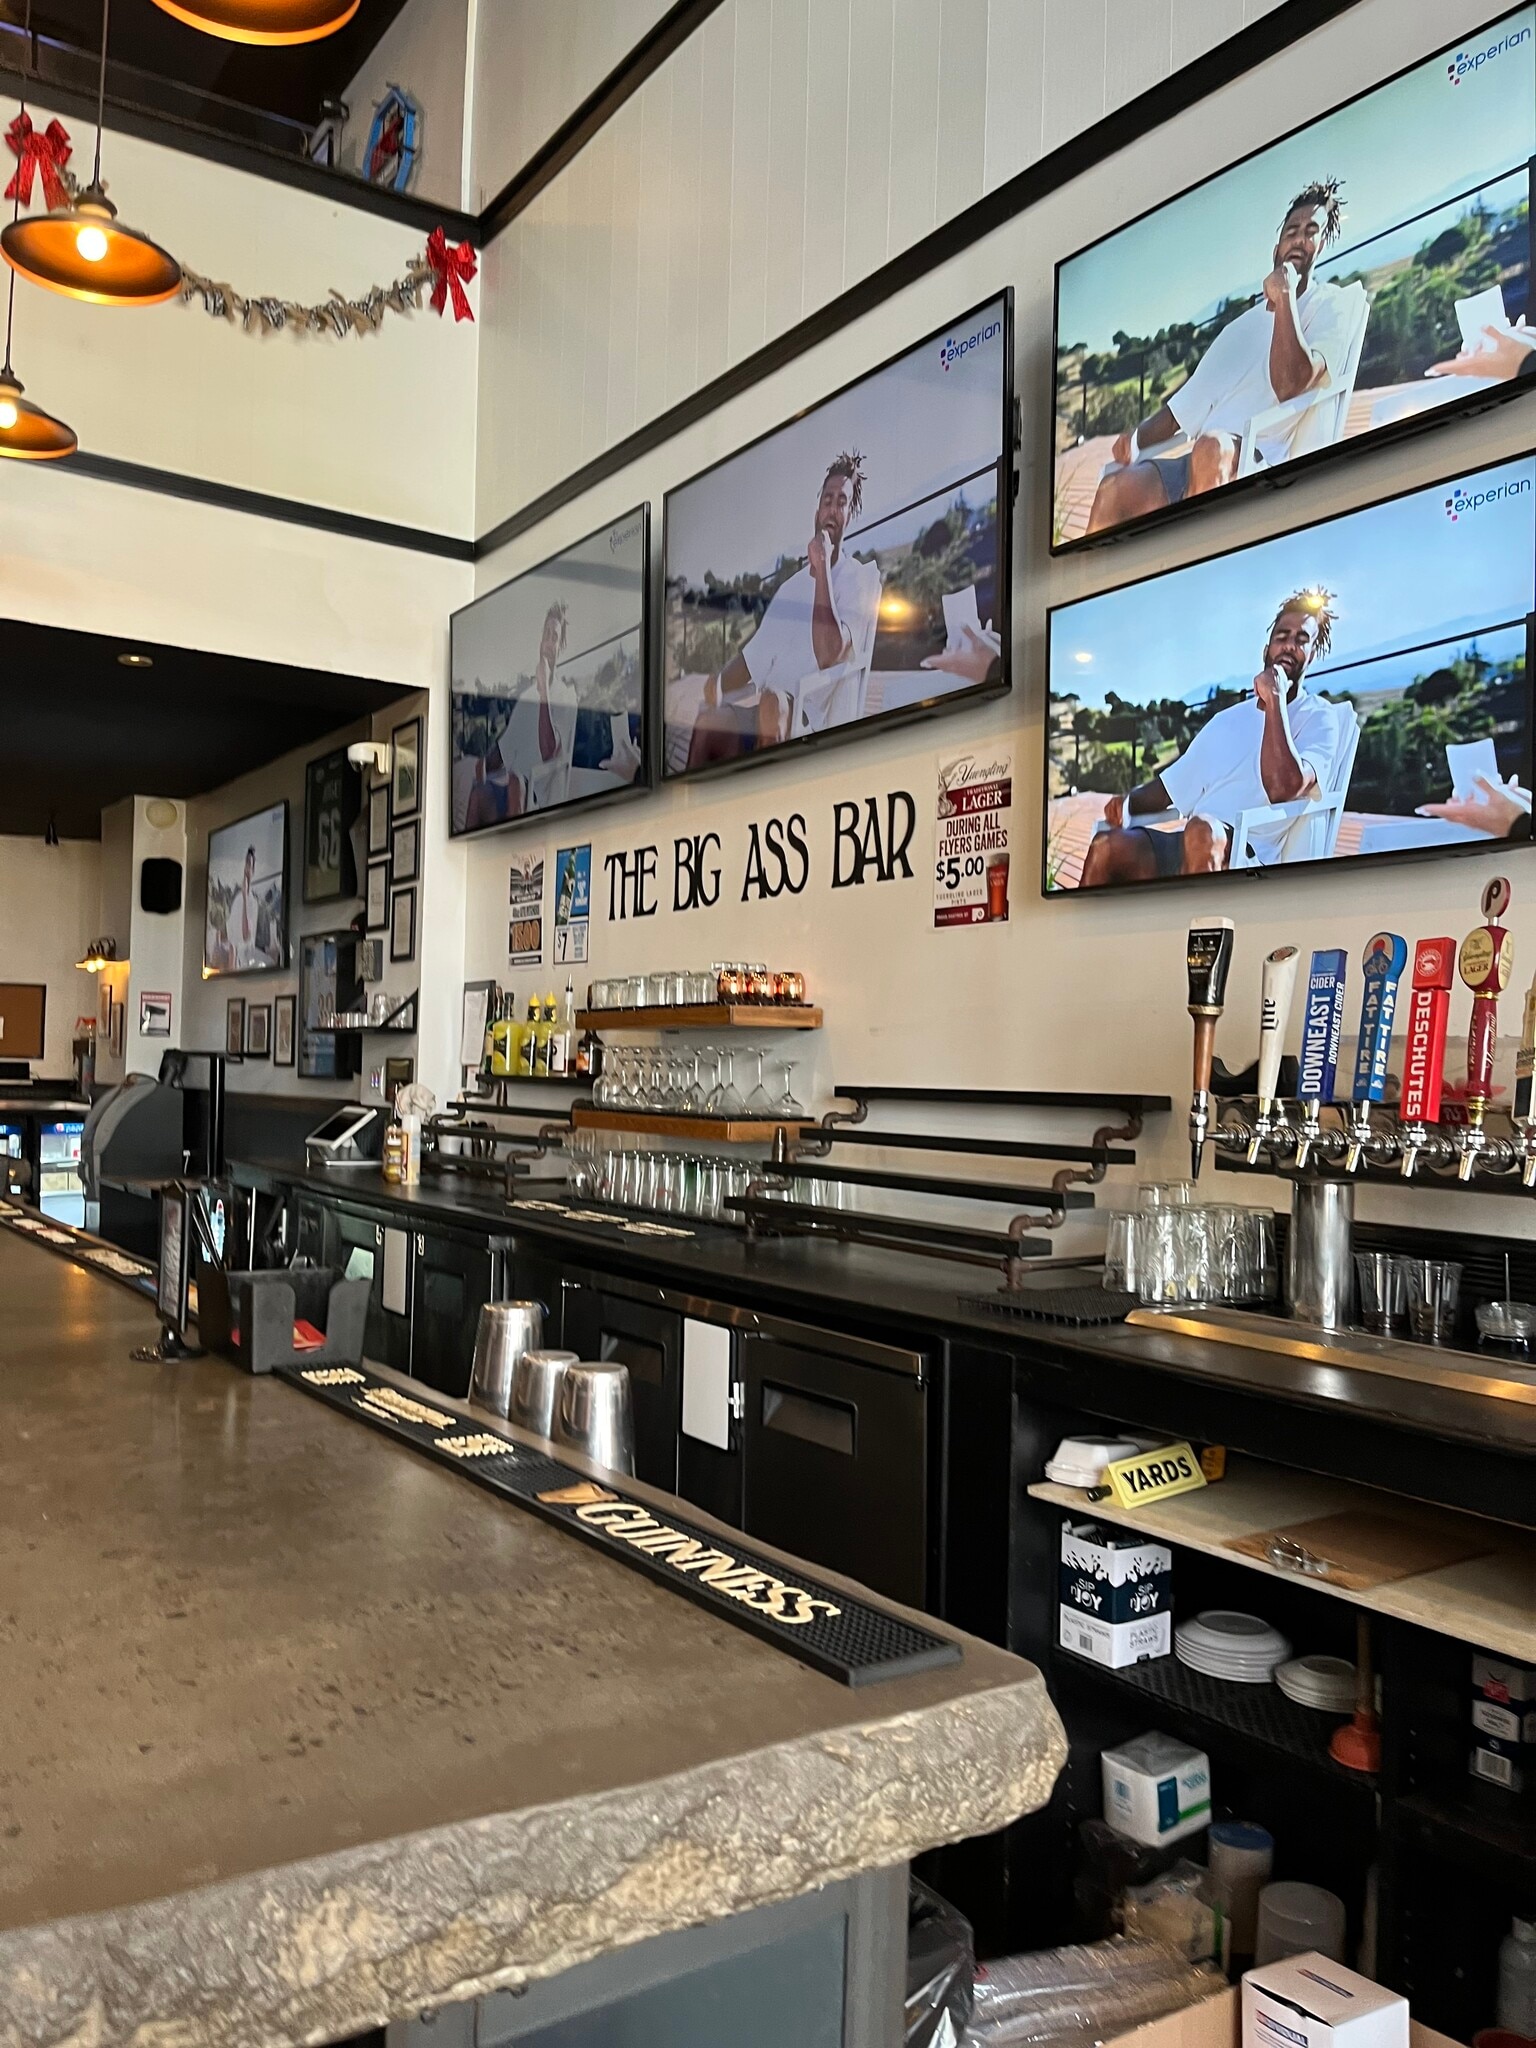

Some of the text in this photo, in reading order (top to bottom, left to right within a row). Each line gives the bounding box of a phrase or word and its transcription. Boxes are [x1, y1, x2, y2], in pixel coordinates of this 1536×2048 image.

[1457, 28, 1531, 75] experian
[947, 321, 1001, 361] experian
[1455, 479, 1531, 512] experian
[962, 790, 1003, 812] LAGER
[939, 830, 1008, 858] FLYERS GAMES
[946, 812, 1001, 838] DURING ALL
[604, 845, 659, 921] THE
[673, 832, 722, 912] BIG
[741, 813, 809, 902] ASS
[831, 791, 916, 888] BAR
[936, 855, 985, 890] $5.00
[1310, 976, 1336, 990] CIDER
[1328, 982, 1345, 1065] DOWNEAST CIDER
[1359, 981, 1381, 1075] FAT TIRE
[1374, 980, 1397, 1077] FAT TIRE
[1301, 994, 1331, 1093] DOWNEAST
[1407, 990, 1432, 1117] DESCHUTES
[1121, 1456, 1193, 1494] YARDS
[575, 1502, 842, 1624] GUINNESS
[1079, 1578, 1096, 1592] SIP
[1138, 1582, 1154, 1596] SIP
